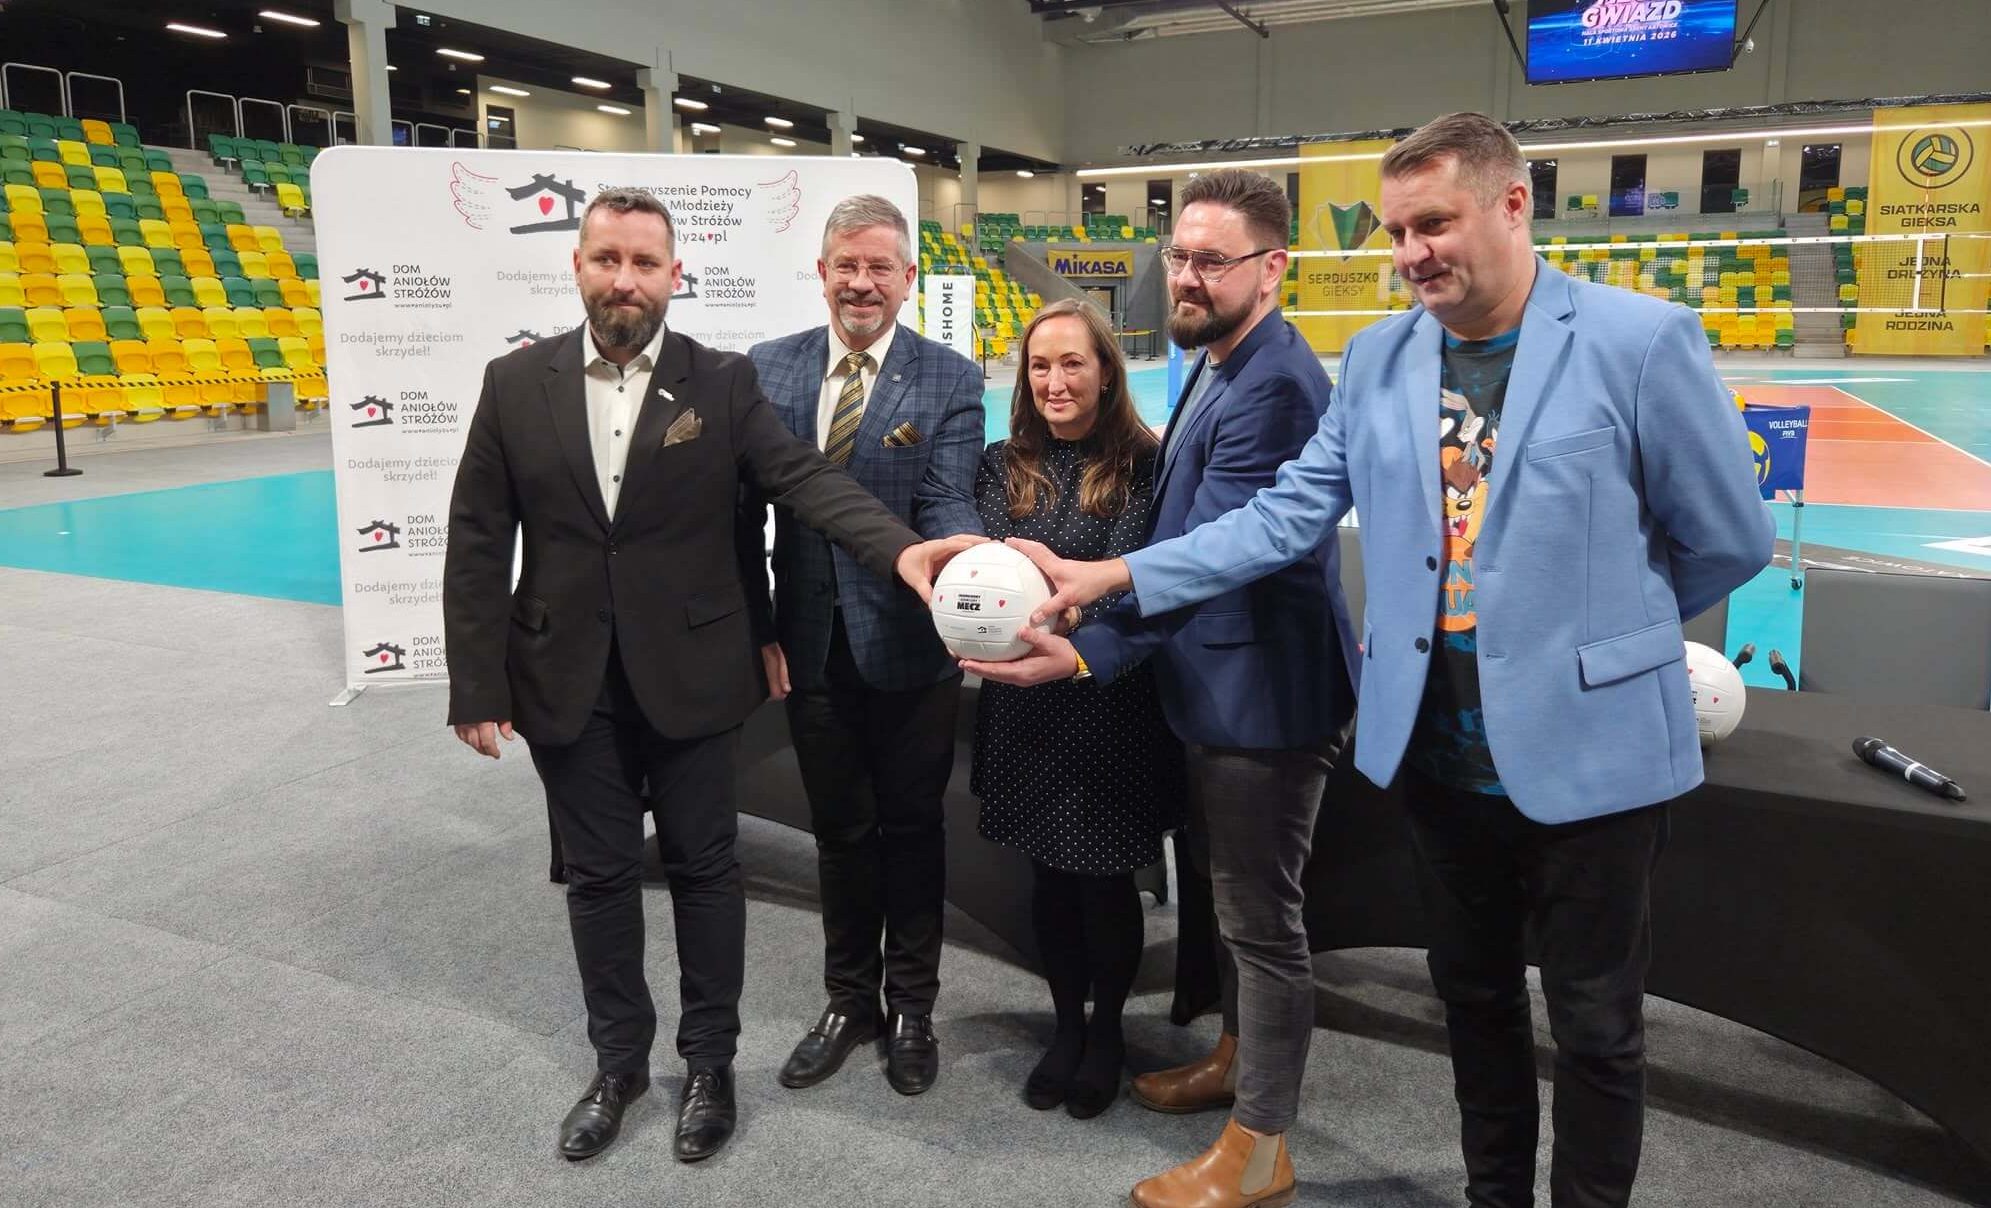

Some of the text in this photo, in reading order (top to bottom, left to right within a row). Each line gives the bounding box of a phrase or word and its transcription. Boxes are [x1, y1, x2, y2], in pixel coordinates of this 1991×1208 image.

[1582, 0, 1682, 28] GWIAZD
[1583, 31, 1677, 46] 11 KWIETNIA 2026
[701, 185, 752, 199] Pomocy
[670, 199, 734, 213] Młodzieży
[1879, 203, 1981, 215] SIATKARSKA
[691, 215, 742, 226] Stróżów
[1901, 217, 1957, 227] GIEKSA
[393, 264, 421, 274] DOM
[704, 266, 730, 276] DOM
[393, 276, 450, 286] ANIOŁÓW
[497, 269, 557, 284] Dodajemy
[704, 277, 756, 287] ANIOŁÓW
[1308, 272, 1379, 284] SERDUSZKO
[394, 287, 451, 298] STRÓŻÓW
[529, 284, 578, 298] skrzyde
[704, 289, 756, 299] STRÓŻÓW
[1886, 320, 1954, 331] RODZINA
[340, 332, 464, 346] Dodajemy dzieciom
[715, 329, 767, 340] dzieciom
[375, 345, 431, 359] skrzydeł!
[400, 390, 428, 401] DOM
[400, 401, 457, 412] ANIOŁÓW
[401, 413, 458, 425] STRÓŻÓW
[1768, 419, 1809, 429] VOLLEYBALL
[347, 456, 458, 471] Dodajemy dziecio
[383, 469, 438, 483] skrzydeł!
[407, 514, 435, 524] DOM
[408, 525, 449, 536] ANIOŁ
[408, 536, 449, 548] STRÓŻ
[354, 581, 417, 595] Dodajemy
[388, 591, 442, 607] skrzydeł
[957, 601, 981, 611] MECZ
[413, 636, 440, 646] DOM
[413, 647, 446, 658] ANIO
[413, 658, 448, 669] STRÓ
